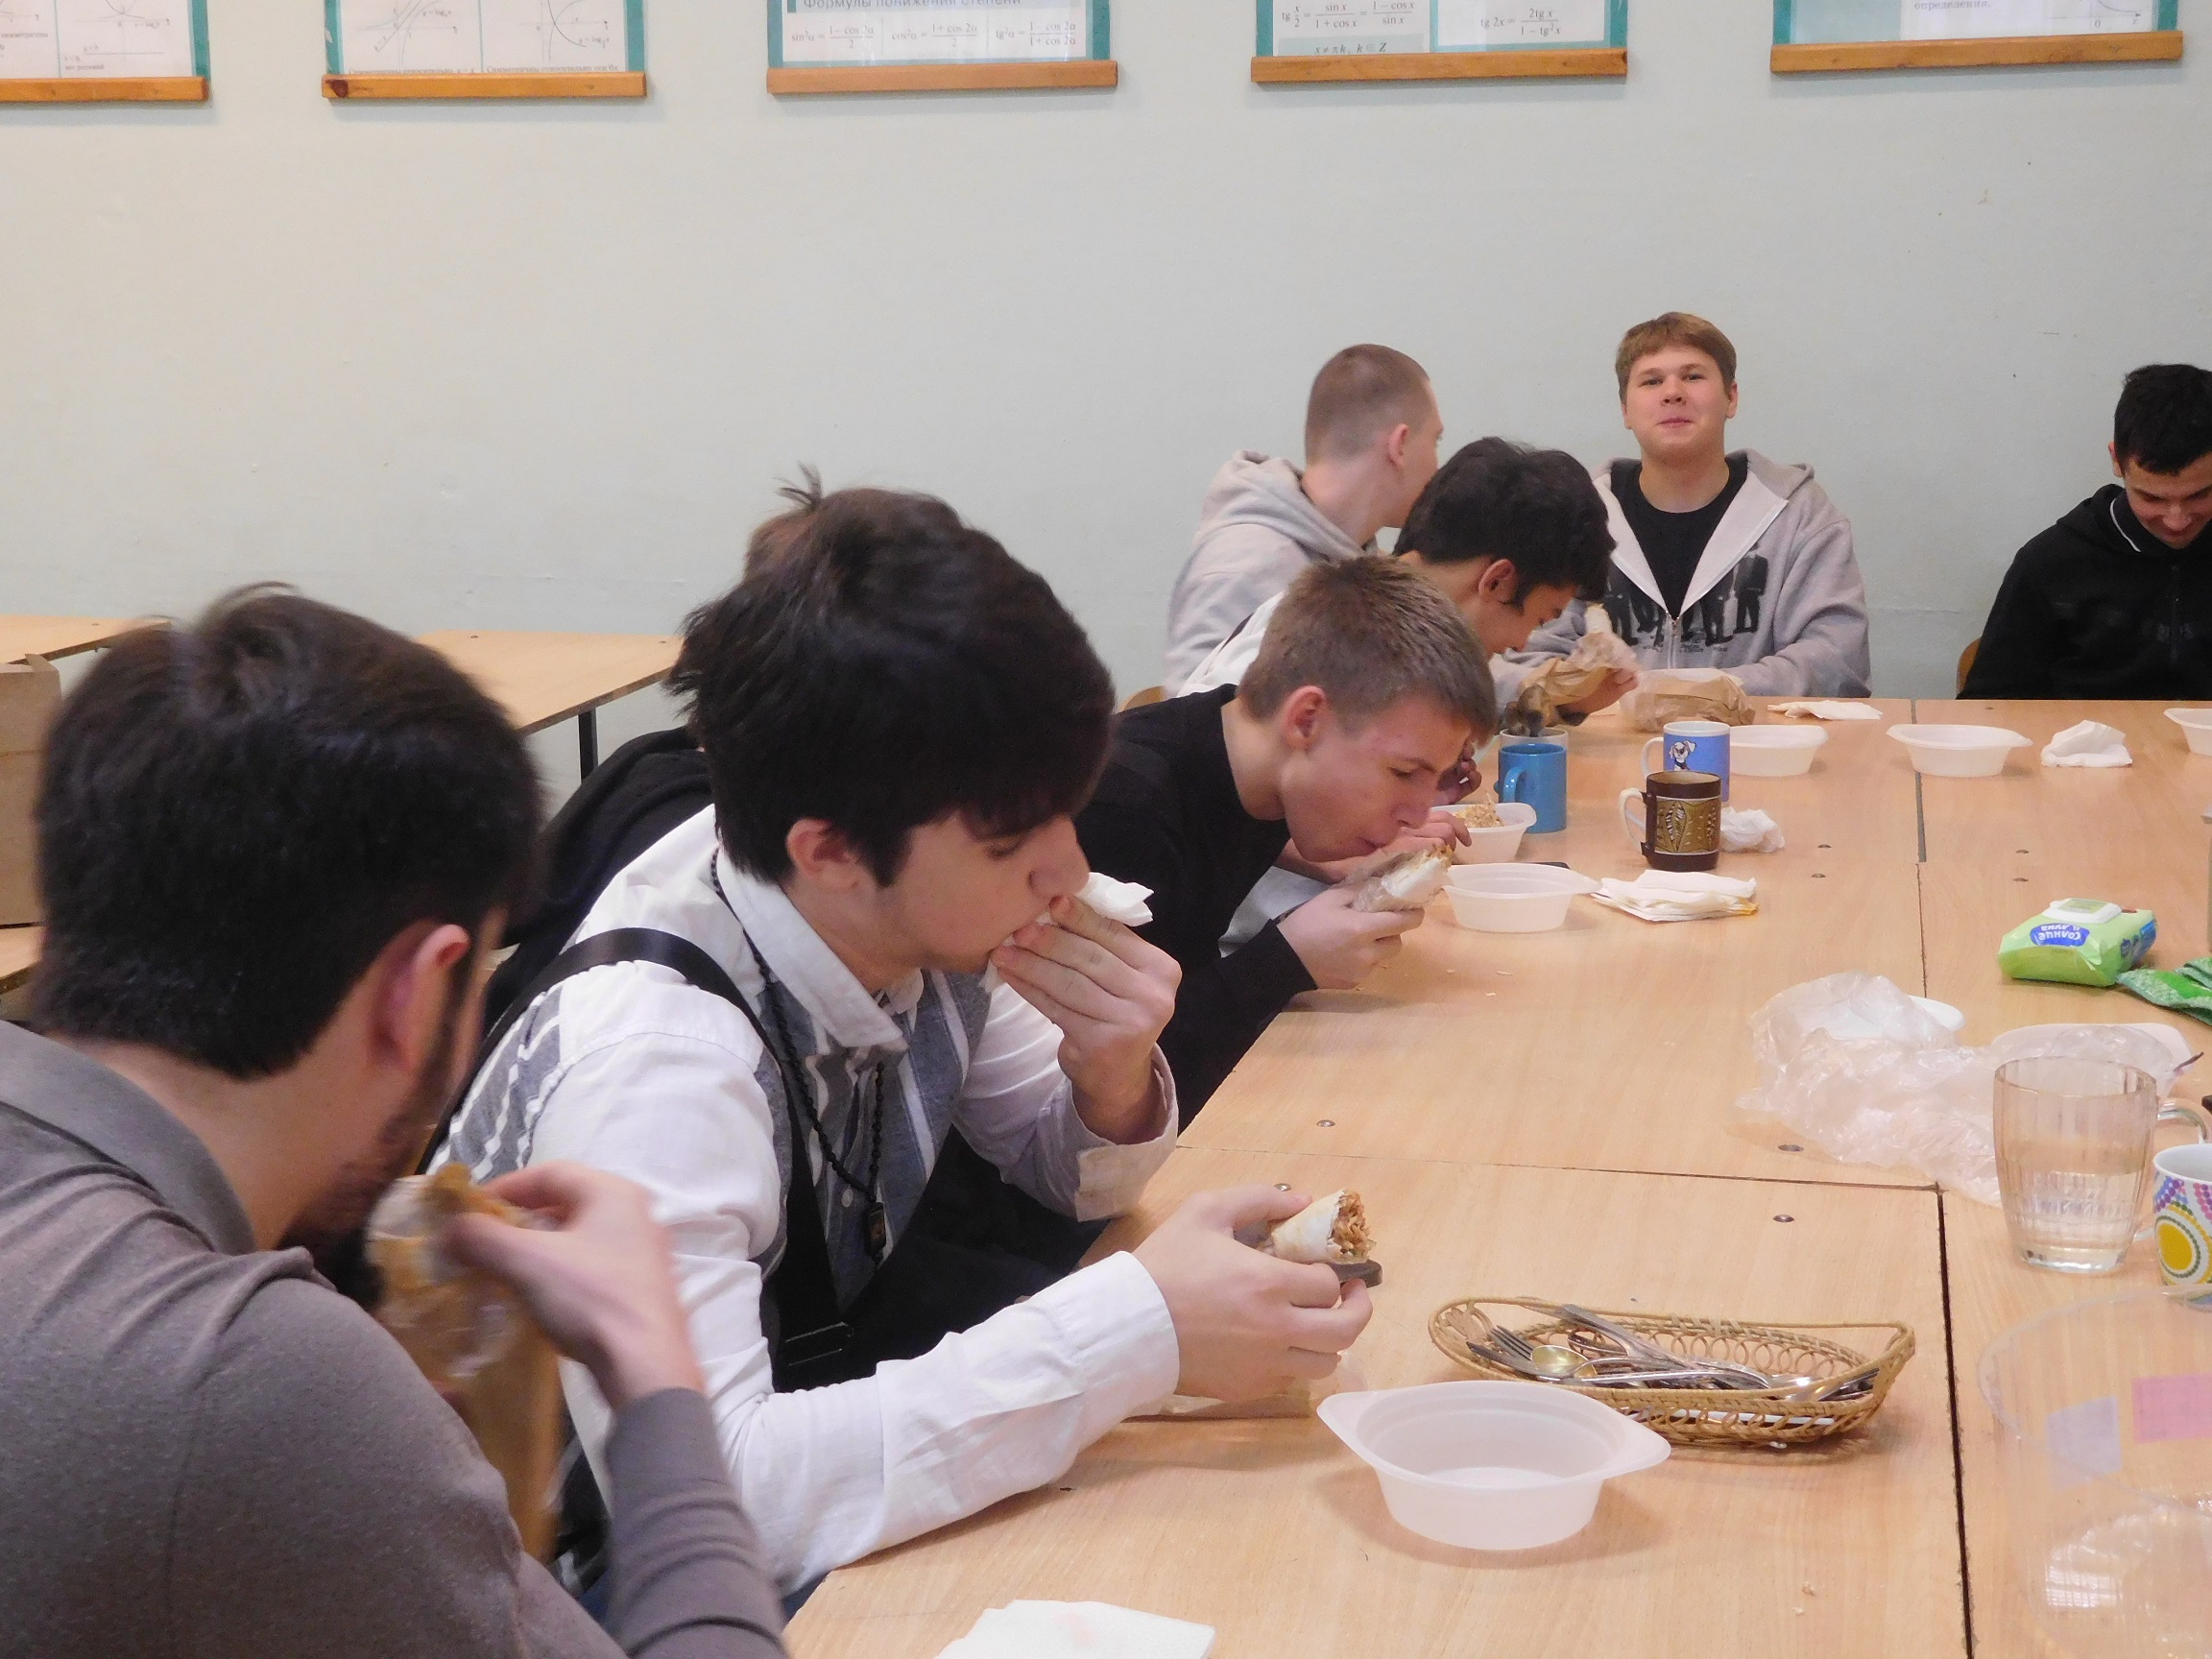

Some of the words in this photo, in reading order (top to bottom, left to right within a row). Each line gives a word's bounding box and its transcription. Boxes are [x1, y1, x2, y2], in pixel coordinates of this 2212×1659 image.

[1325, 3, 1339, 12] sin
[1913, 0, 1991, 11] определения.
[1282, 12, 1290, 22] tg
[1382, 15, 1397, 24] sin
[1480, 18, 1490, 29] tg
[1045, 37, 1061, 46] cos
